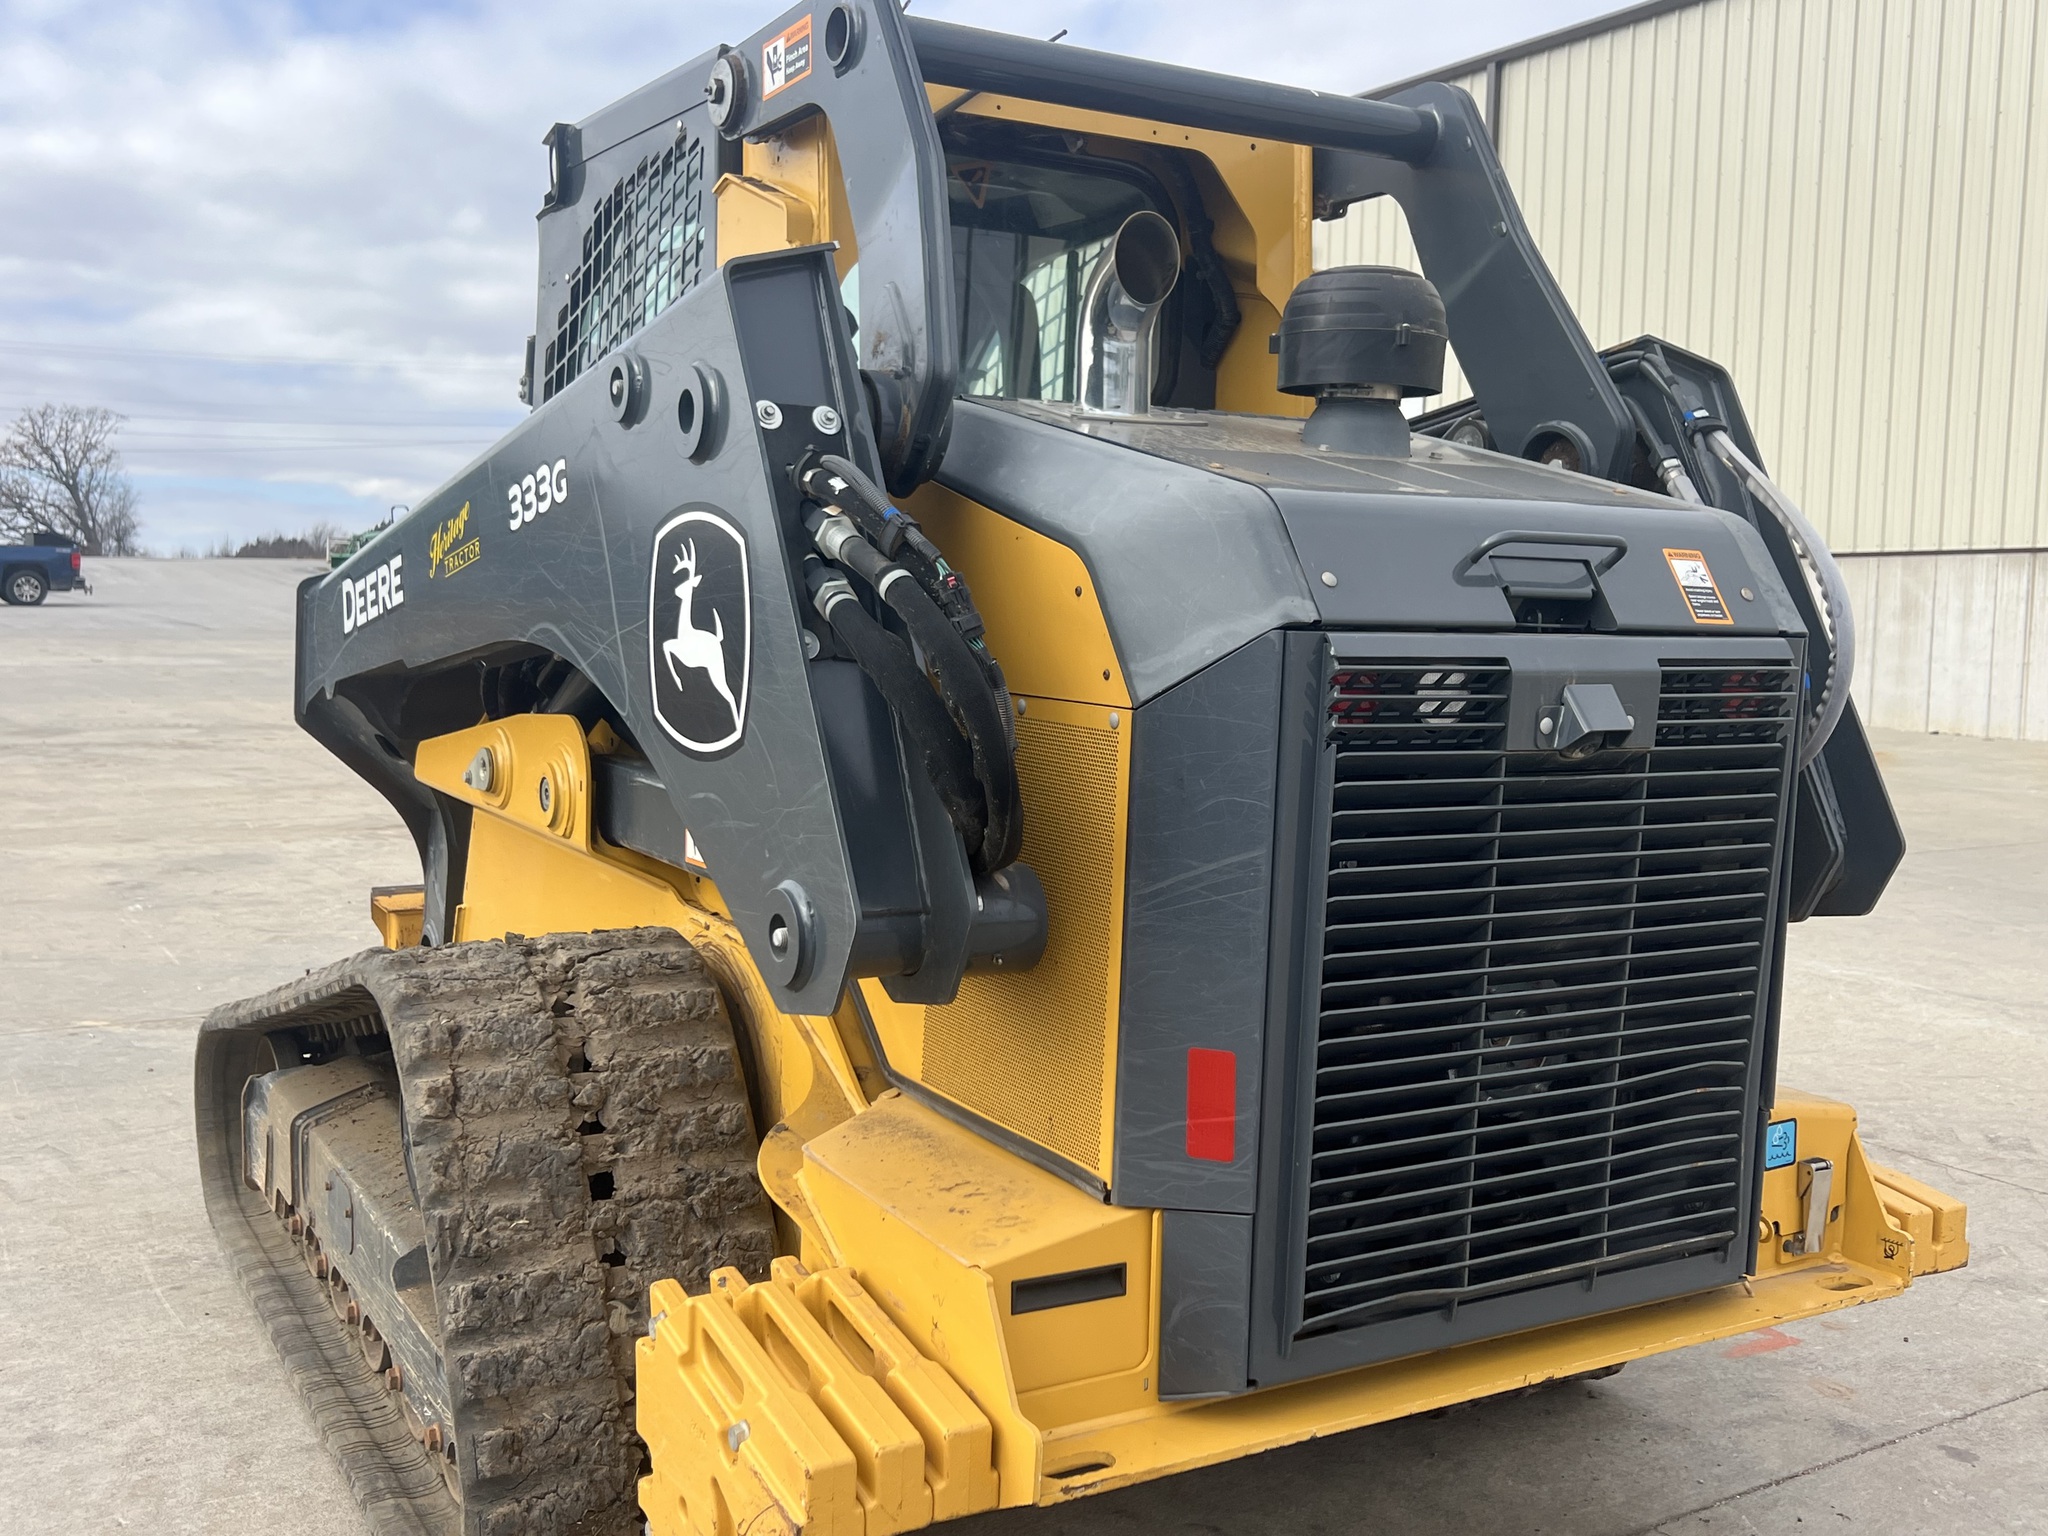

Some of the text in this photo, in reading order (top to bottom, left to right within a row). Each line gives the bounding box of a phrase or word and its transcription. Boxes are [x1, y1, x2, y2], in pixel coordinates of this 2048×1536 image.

[790, 21, 809, 37] WARNING
[785, 44, 809, 64] Pinch Area
[508, 458, 568, 531] 333G
[429, 500, 470, 579] Heritage
[1673, 551, 1702, 560] WARNING
[444, 541, 480, 574] TRACTOR
[341, 553, 405, 635] DEERE
